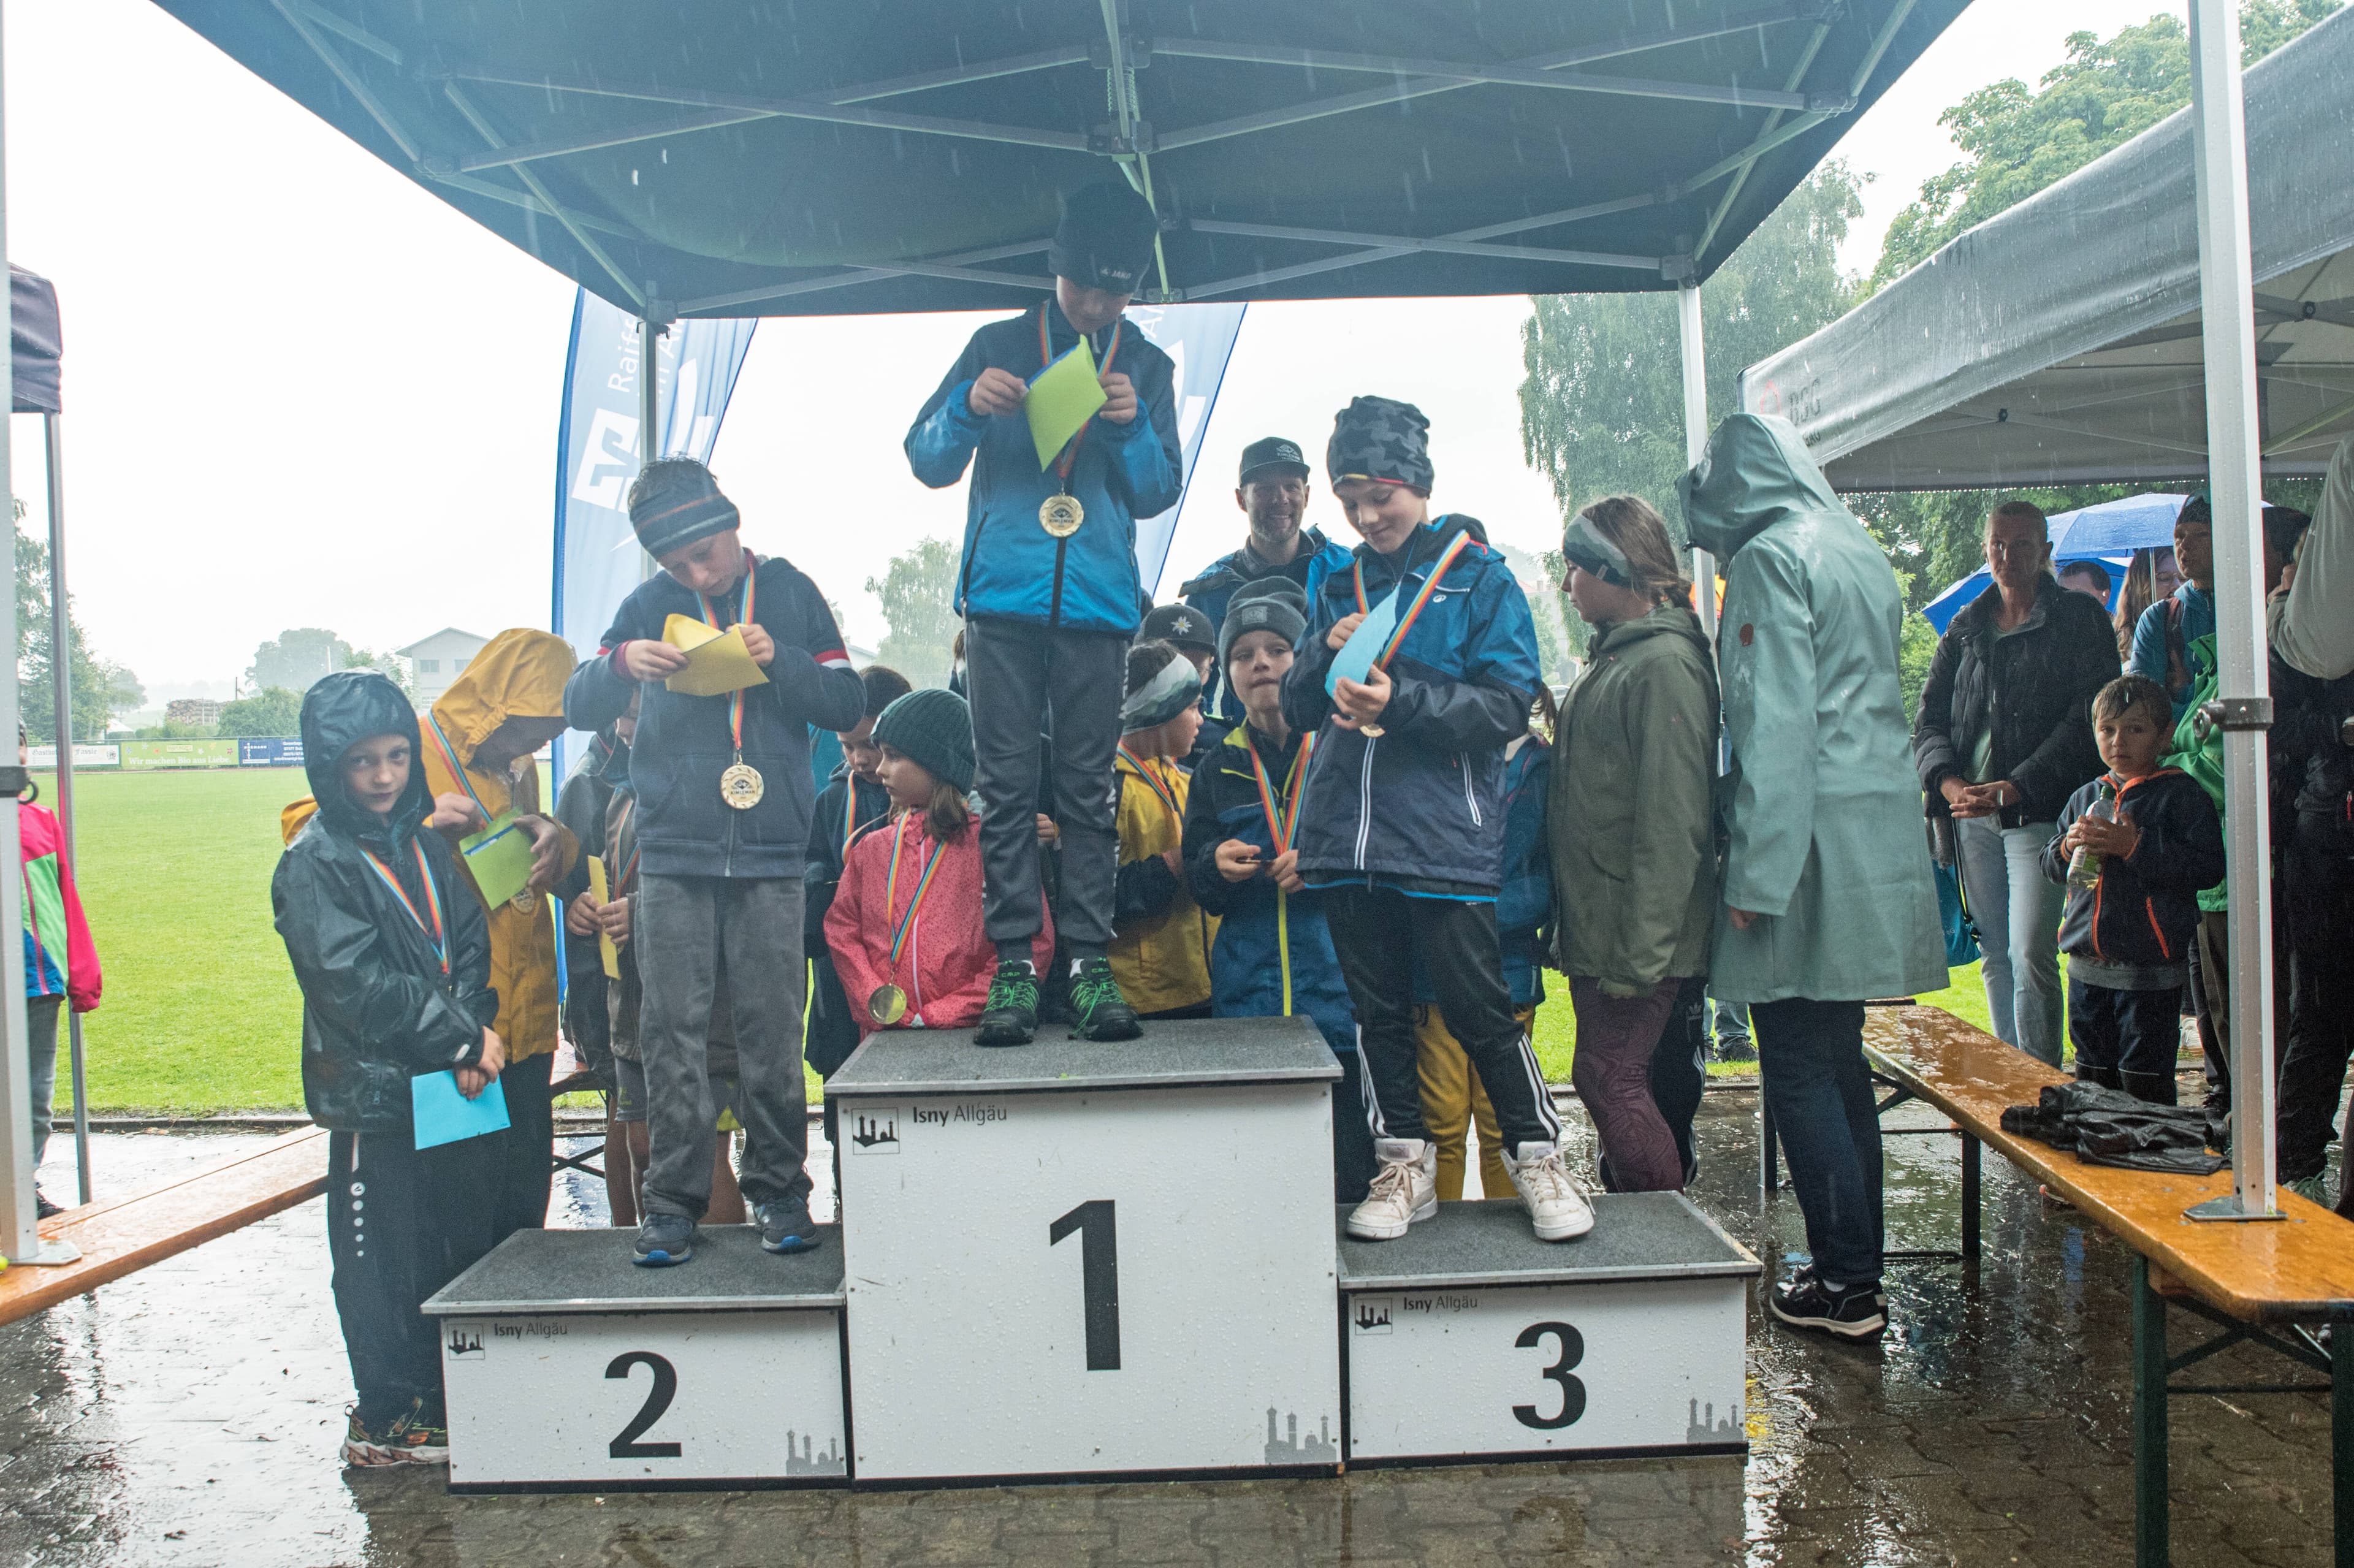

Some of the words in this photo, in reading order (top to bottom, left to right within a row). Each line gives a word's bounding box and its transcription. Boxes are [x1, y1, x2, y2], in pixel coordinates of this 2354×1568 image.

[145, 756, 177, 765] machen
[913, 1106, 950, 1127] Isny
[954, 1105, 1007, 1126] Allgäu
[1049, 1200, 1121, 1372] 1
[1403, 1296, 1433, 1313] Isny
[1436, 1295, 1477, 1312] Allgäu
[494, 1323, 522, 1339] Isny
[526, 1322, 568, 1339] Allgäu
[1512, 1321, 1587, 1430] 3
[604, 1350, 682, 1459] 2
